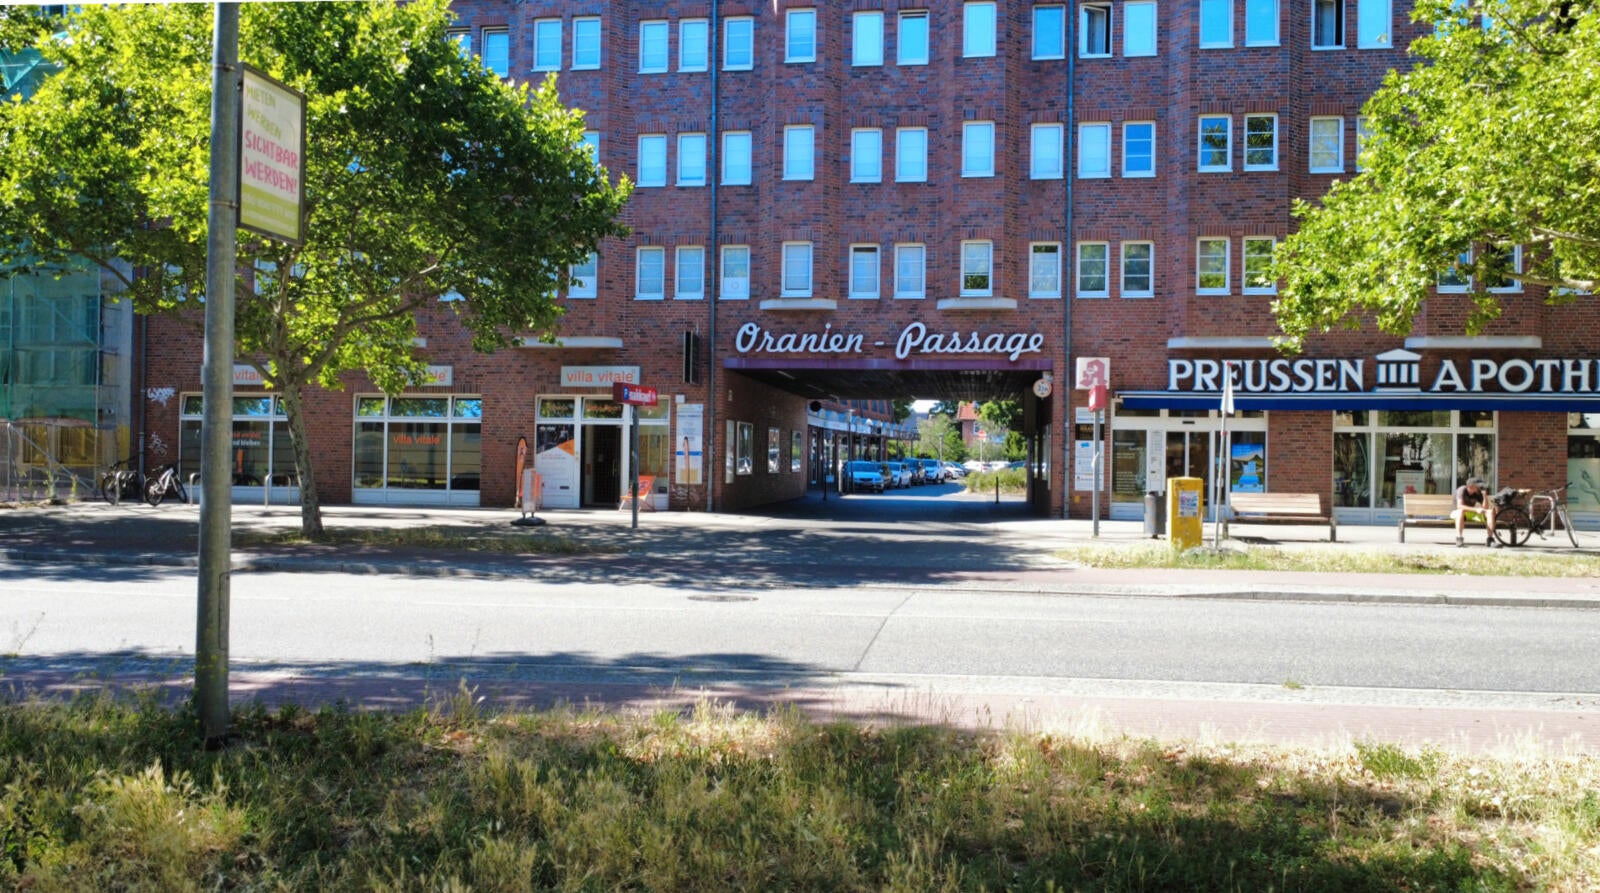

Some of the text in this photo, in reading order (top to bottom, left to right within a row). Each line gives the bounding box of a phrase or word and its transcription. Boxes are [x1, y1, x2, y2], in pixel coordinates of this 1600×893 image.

[245, 130, 298, 170] SICHTBAR
[245, 156, 297, 195] WERDEN!
[736, 322, 864, 353] Oranien
[895, 321, 1044, 362] Passage
[566, 370, 593, 382] villa
[1168, 358, 1600, 392] PREUSSEN APOTH
[394, 434, 413, 445] villa
